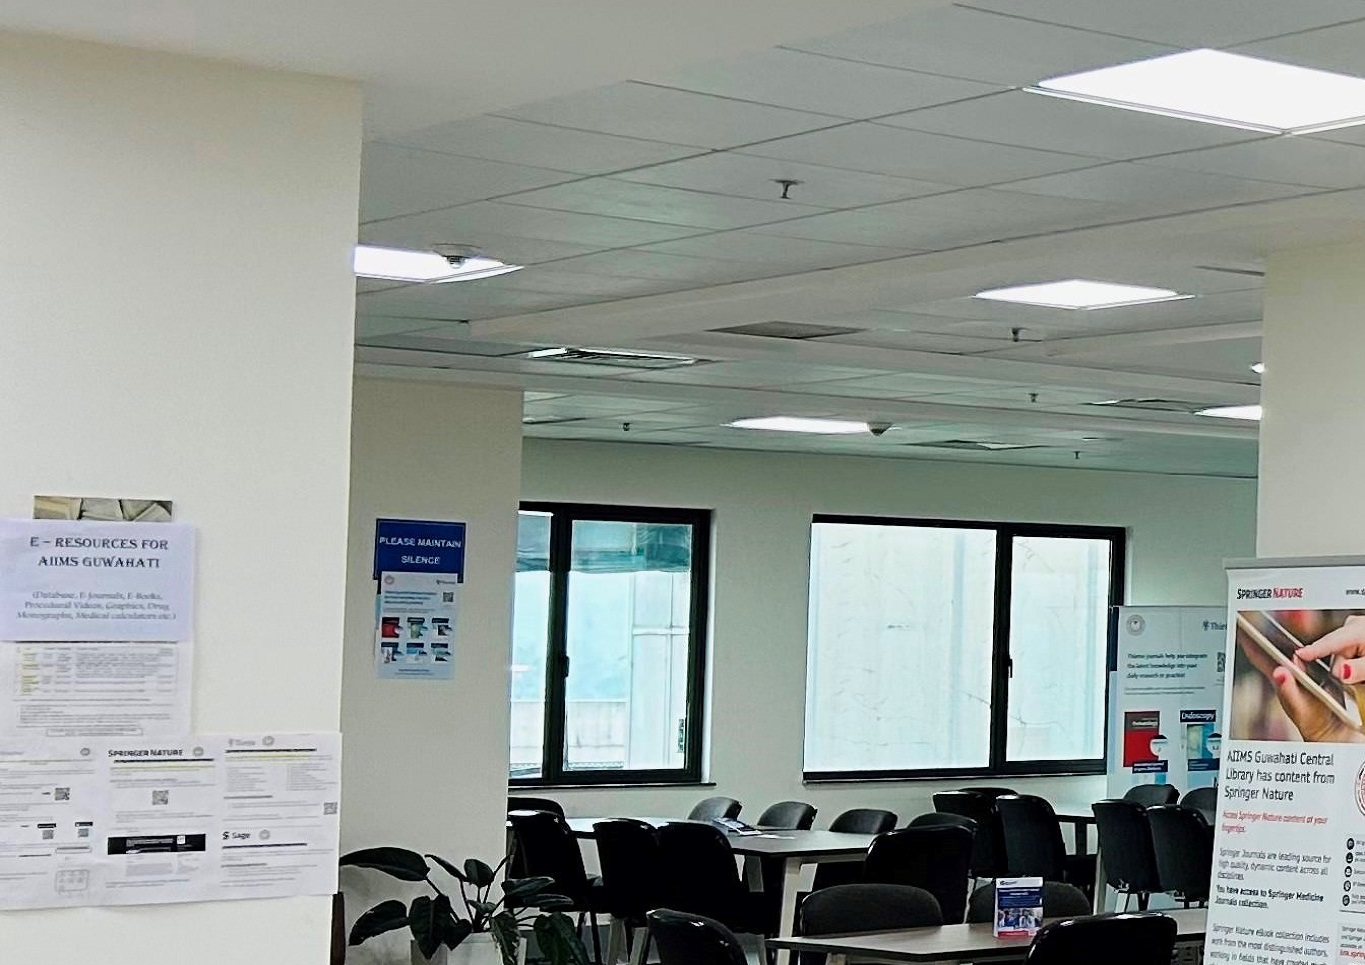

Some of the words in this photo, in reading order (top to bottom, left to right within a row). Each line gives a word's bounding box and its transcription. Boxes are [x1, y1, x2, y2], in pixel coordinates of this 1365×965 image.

[30, 536, 40, 547] E
[54, 538, 138, 549] RESOURCES
[141, 539, 169, 550] FOR
[379, 536, 416, 546] PLEASE
[417, 538, 462, 548] MAINTAIN
[37, 556, 79, 567] AIIMS
[82, 556, 161, 568] GUWAHATI
[400, 555, 441, 565] SILENCE
[1236, 588, 1273, 600] SPRINGER
[1272, 587, 1304, 599] NATURE
[107, 749, 149, 758] SPRINGER
[150, 749, 184, 757] NATURE
[1227, 750, 1253, 763] AIIMS
[1254, 750, 1298, 765] Guwahati
[1300, 752, 1335, 766] Central
[1225, 768, 1254, 784] Library
[1255, 769, 1273, 782] has
[1274, 771, 1311, 784] content
[1312, 770, 1336, 785] from
[1224, 785, 1260, 801] Springer
[1261, 787, 1294, 801] Nature
